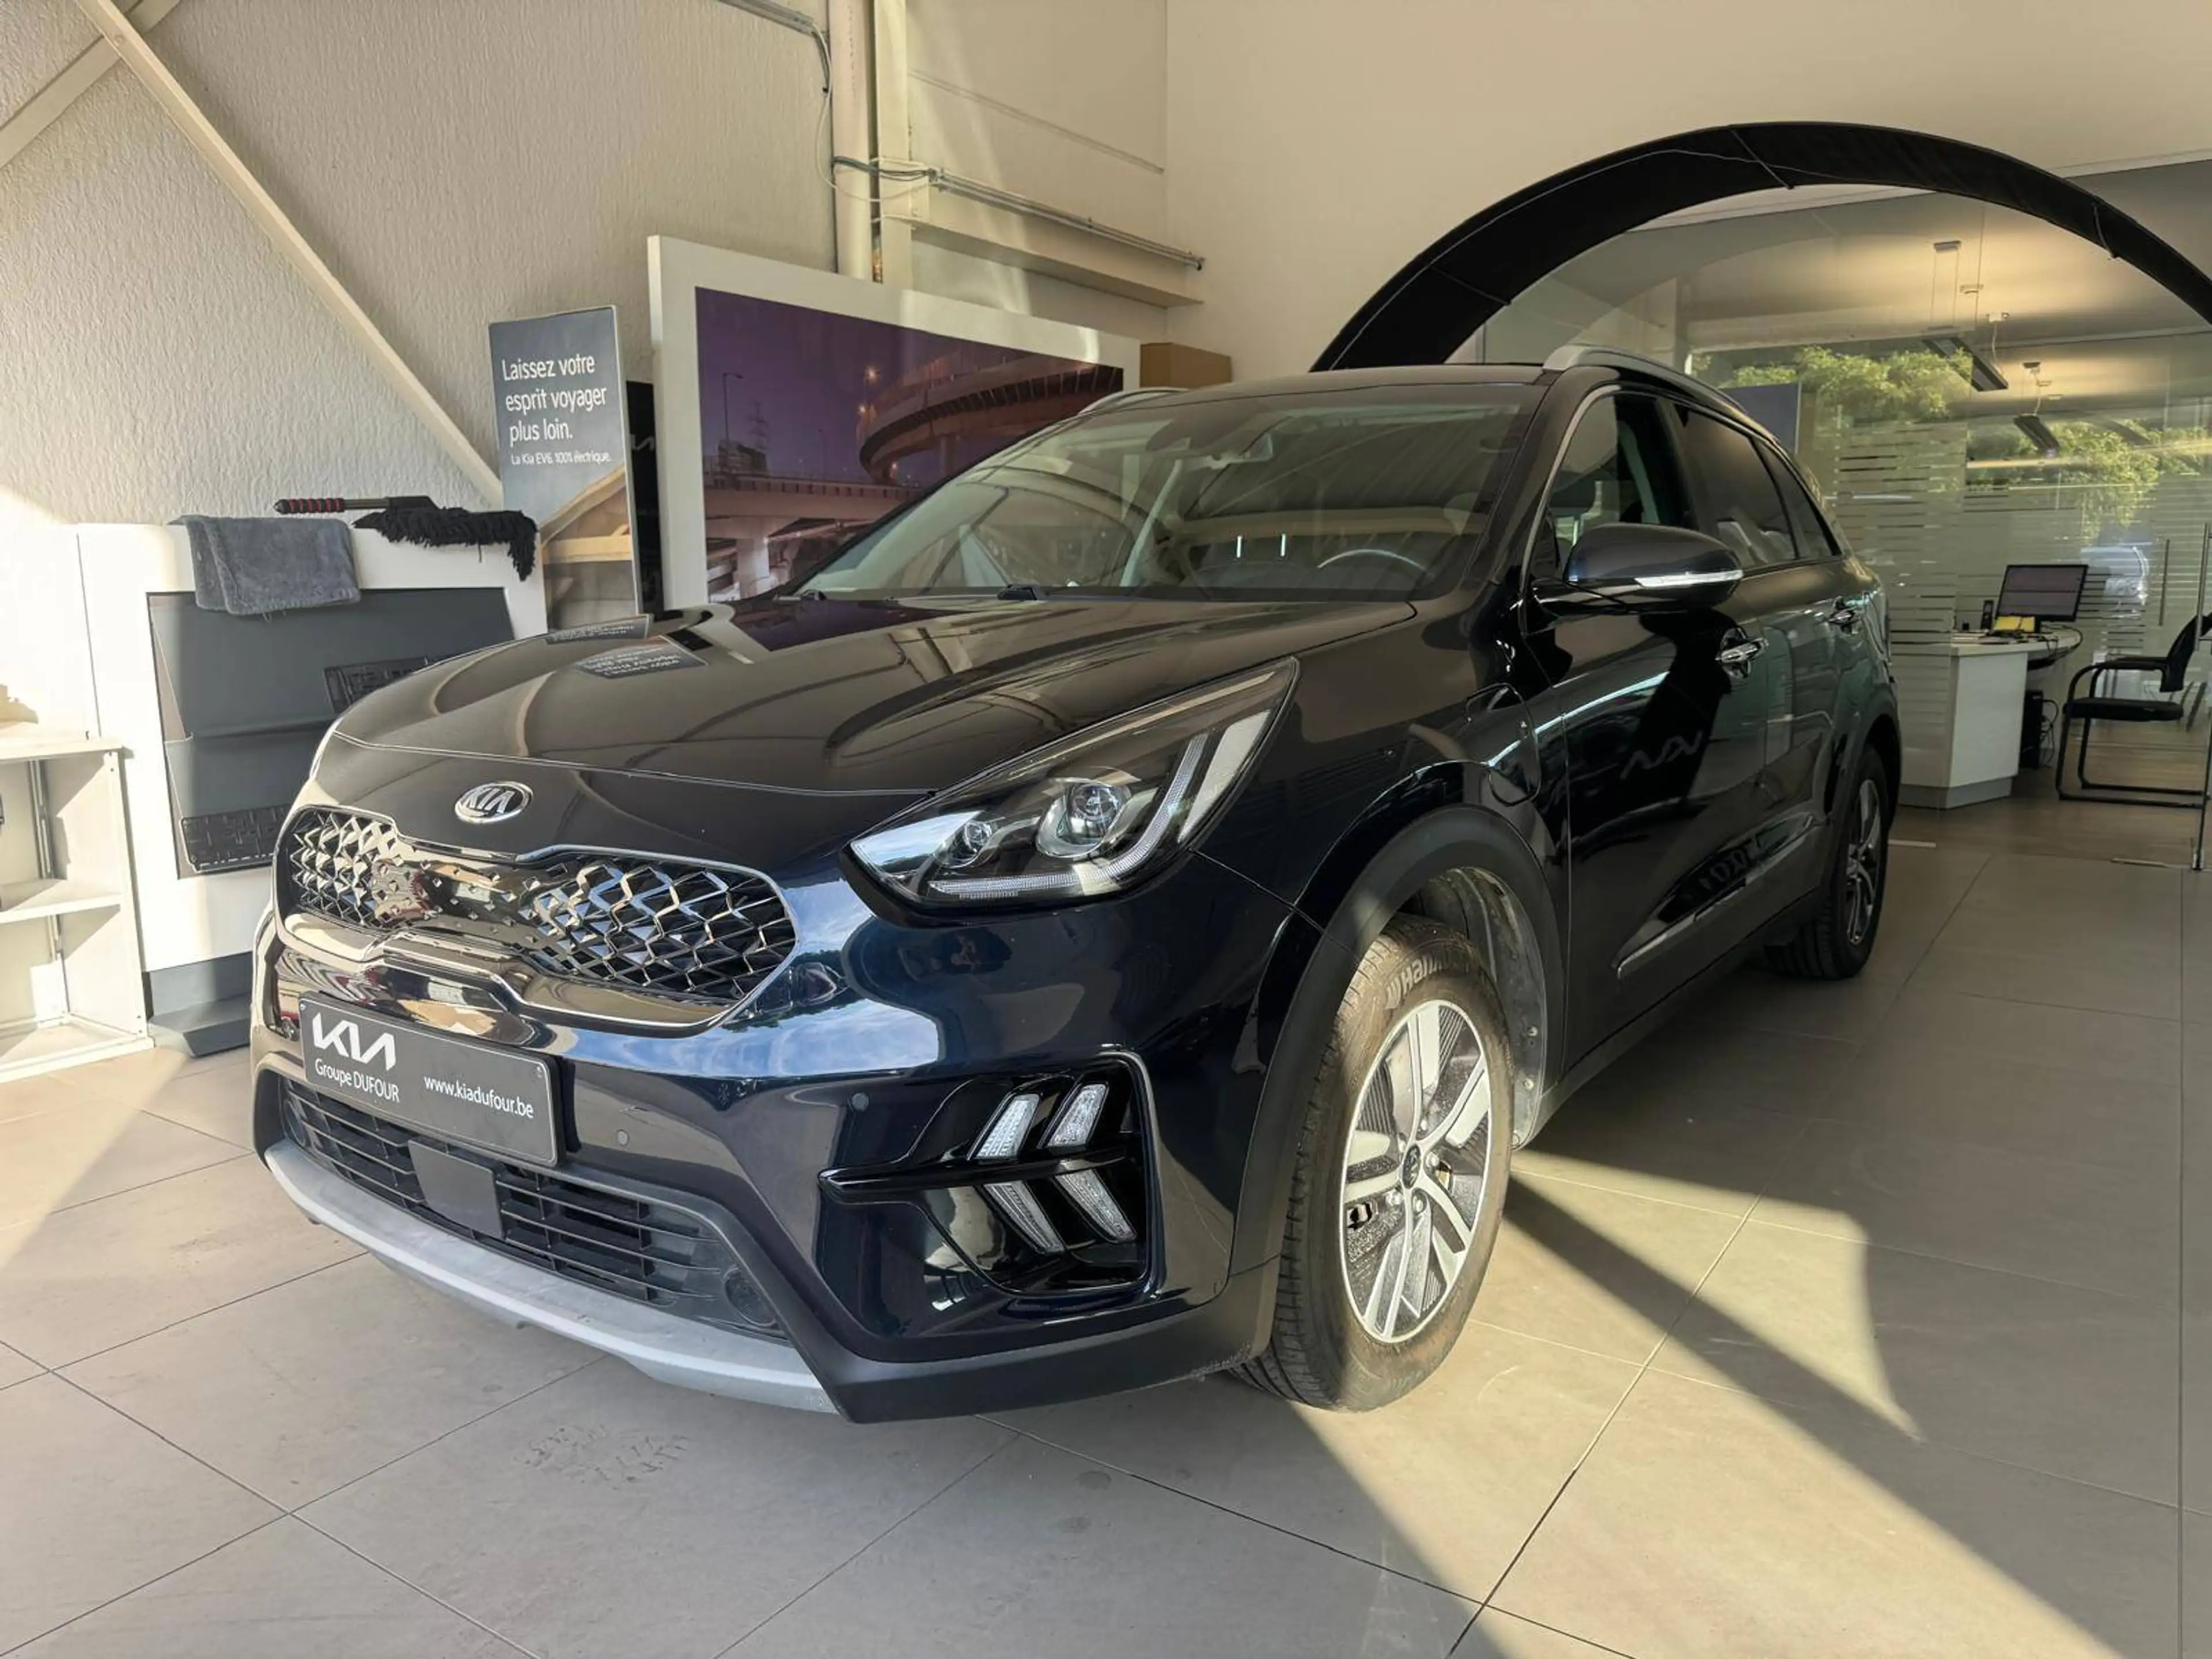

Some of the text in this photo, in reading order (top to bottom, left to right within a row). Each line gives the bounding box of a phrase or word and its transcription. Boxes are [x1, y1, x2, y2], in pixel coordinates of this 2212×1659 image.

[502, 353, 595, 381] Laissez votre
[506, 387, 607, 415] esprit voyager
[510, 418, 573, 448] plus loin.
[535, 452, 553, 464] EV6
[462, 787, 516, 814] KIA
[312, 1012, 396, 1071] KIA
[315, 1058, 400, 1103] Groupe DUFOUR
[424, 1075, 534, 1119] www.kiadufour.be
